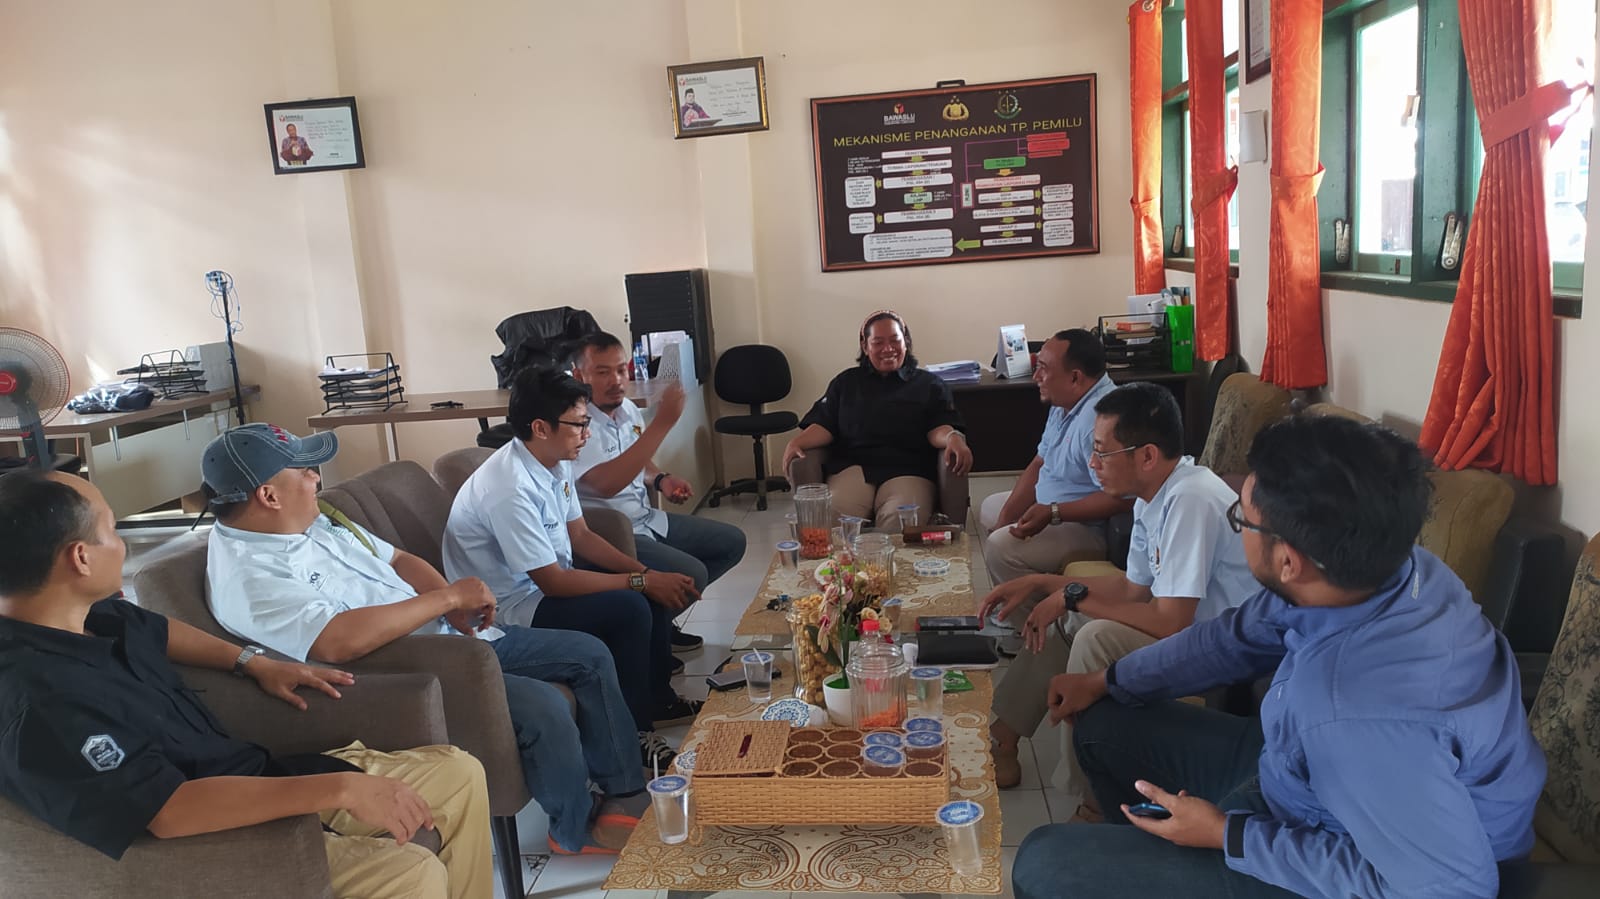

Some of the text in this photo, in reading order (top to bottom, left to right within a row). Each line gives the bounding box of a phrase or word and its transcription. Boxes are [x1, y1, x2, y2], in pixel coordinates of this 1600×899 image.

[883, 113, 916, 121] BAWASLU
[833, 132, 910, 147] MEKANISME
[915, 125, 1007, 140] PENANGANAN
[1033, 117, 1082, 130] PEMILU
